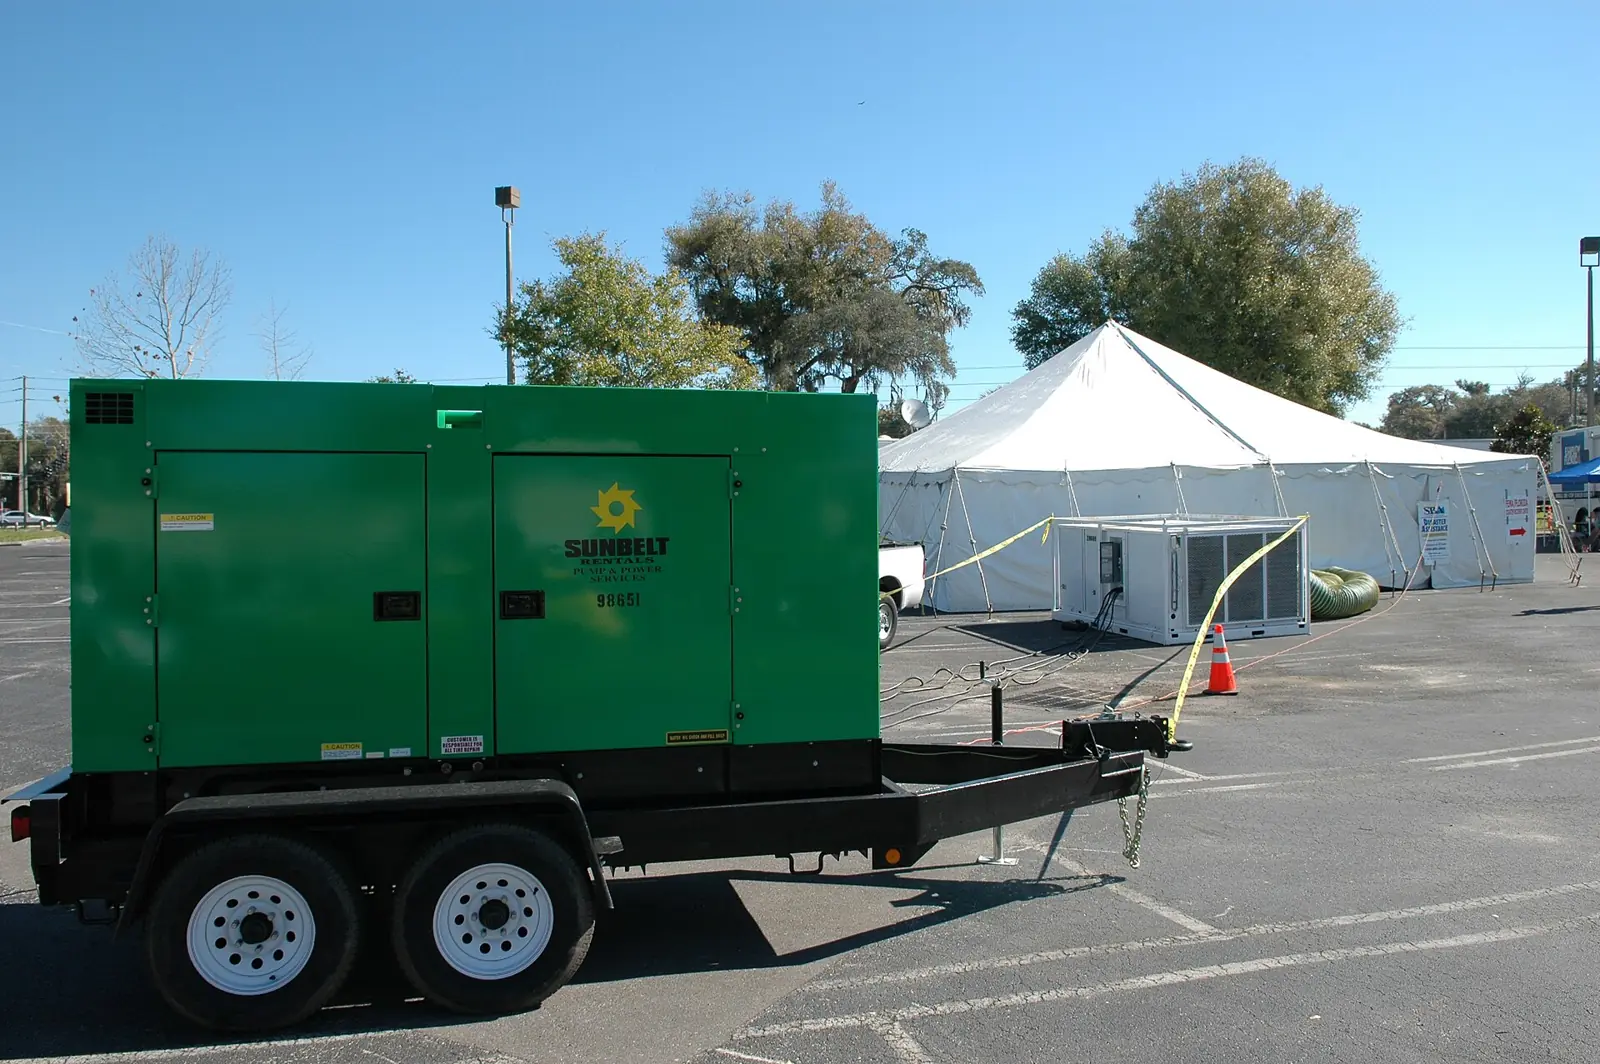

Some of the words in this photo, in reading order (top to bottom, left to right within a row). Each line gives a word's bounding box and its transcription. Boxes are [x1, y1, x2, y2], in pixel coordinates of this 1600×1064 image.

[564, 537, 670, 558] SUNBELT
[580, 557, 655, 565] RENTALS
[573, 567, 606, 576] PUMP
[609, 567, 617, 575] &
[621, 566, 662, 574] POWER
[589, 575, 646, 583] SERVICES
[597, 592, 640, 608] 98651
